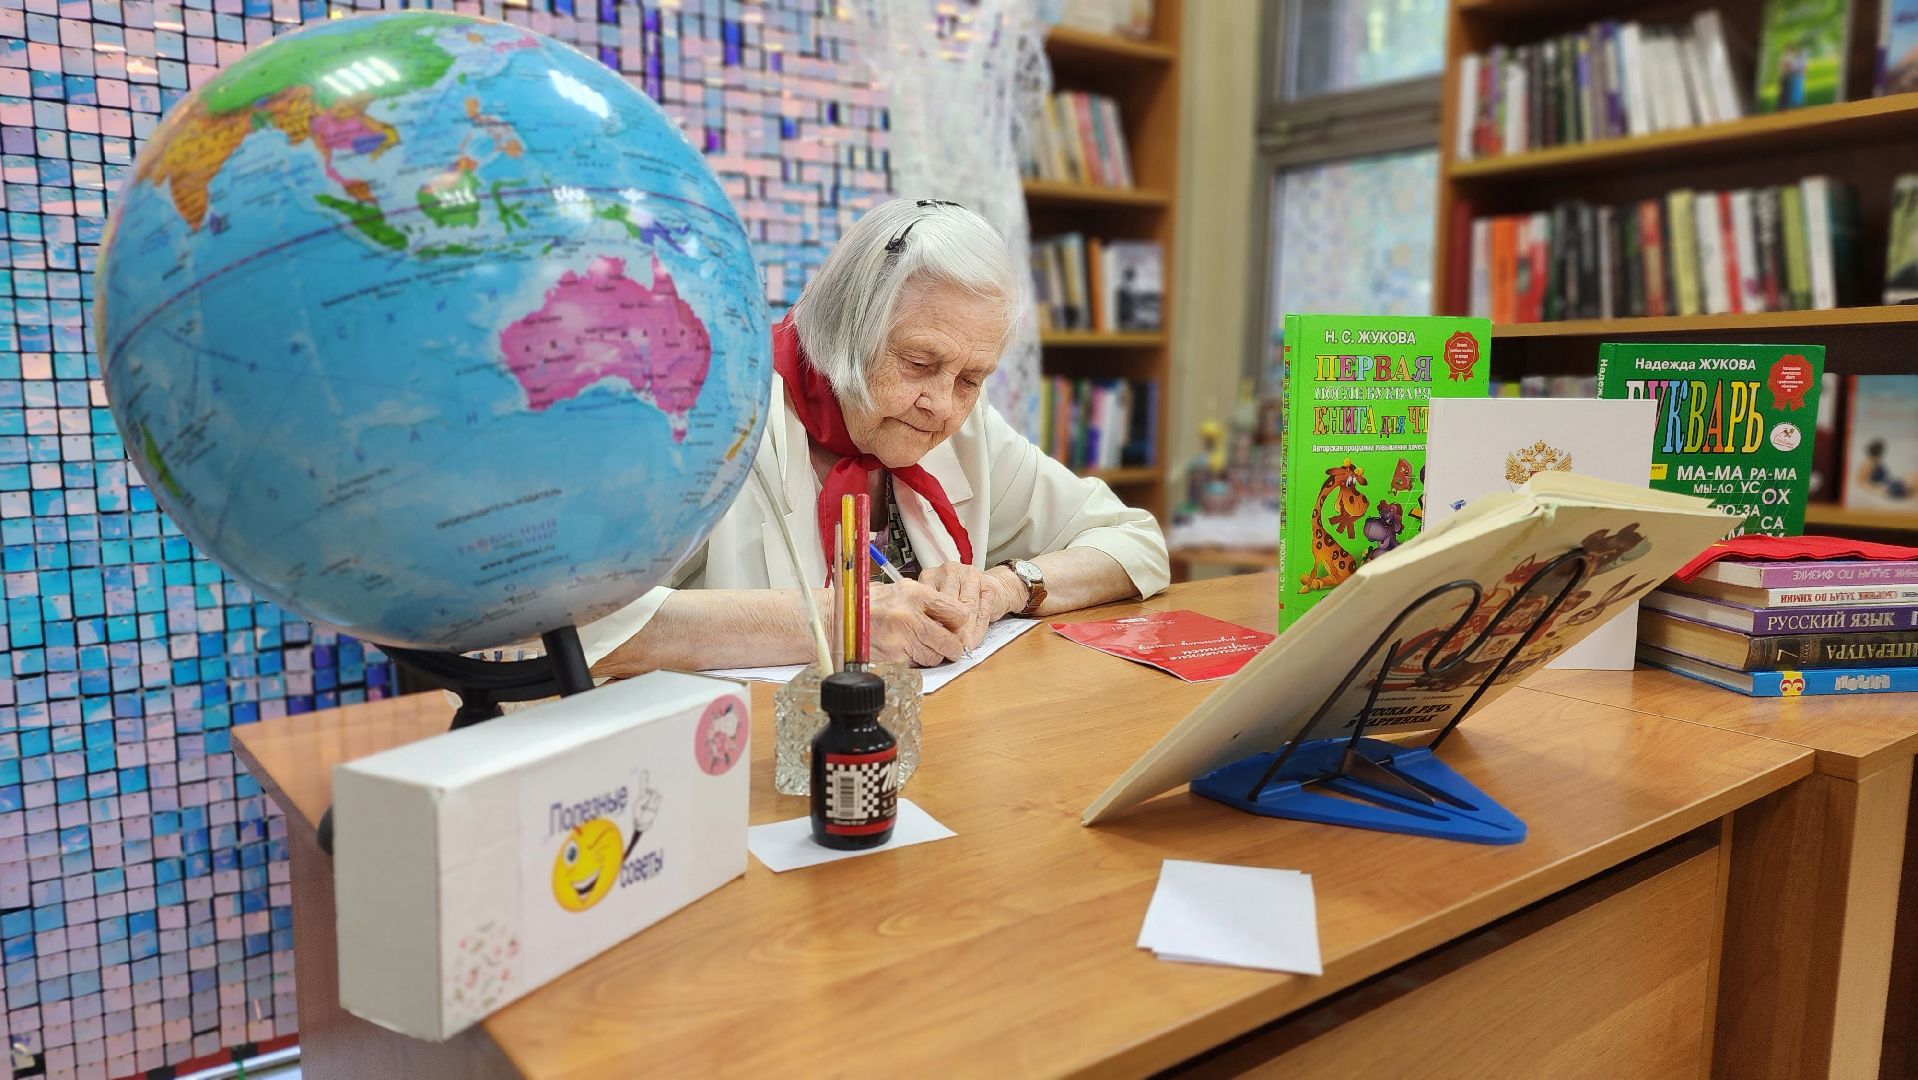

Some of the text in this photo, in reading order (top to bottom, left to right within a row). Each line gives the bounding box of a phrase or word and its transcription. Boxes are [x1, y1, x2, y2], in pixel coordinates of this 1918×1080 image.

[1325, 330, 1416, 345] Н. С. ЖУКОВА
[1314, 355, 1433, 382] ПЕРВАЯ
[1636, 358, 1756, 372] Надежда ЖУКОВА
[1314, 386, 1431, 400] ПОСЛЕ БУКВАРЯ
[1313, 405, 1378, 435] КНИГА
[1677, 466, 1743, 480] МА-МА
[1750, 468, 1798, 480] РА-МА
[1693, 481, 1760, 494] МЫ-ЛО УС
[1762, 488, 1790, 505] ОХ
[1760, 516, 1784, 530] СА
[1792, 570, 1835, 581] ФИЗИКЕ
[1838, 568, 1854, 580] ПО
[1857, 567, 1890, 578] ЗАДАЧ
[1780, 594, 1812, 604] ХИМИИ
[1815, 592, 1828, 602] ПО
[1767, 610, 1846, 631] РУССКИЙ
[1850, 612, 1896, 628] ЯЗЫК
[1416, 704, 1452, 714] РЕЧЬ
[550, 785, 628, 837] Полезные
[620, 848, 664, 888] советы
